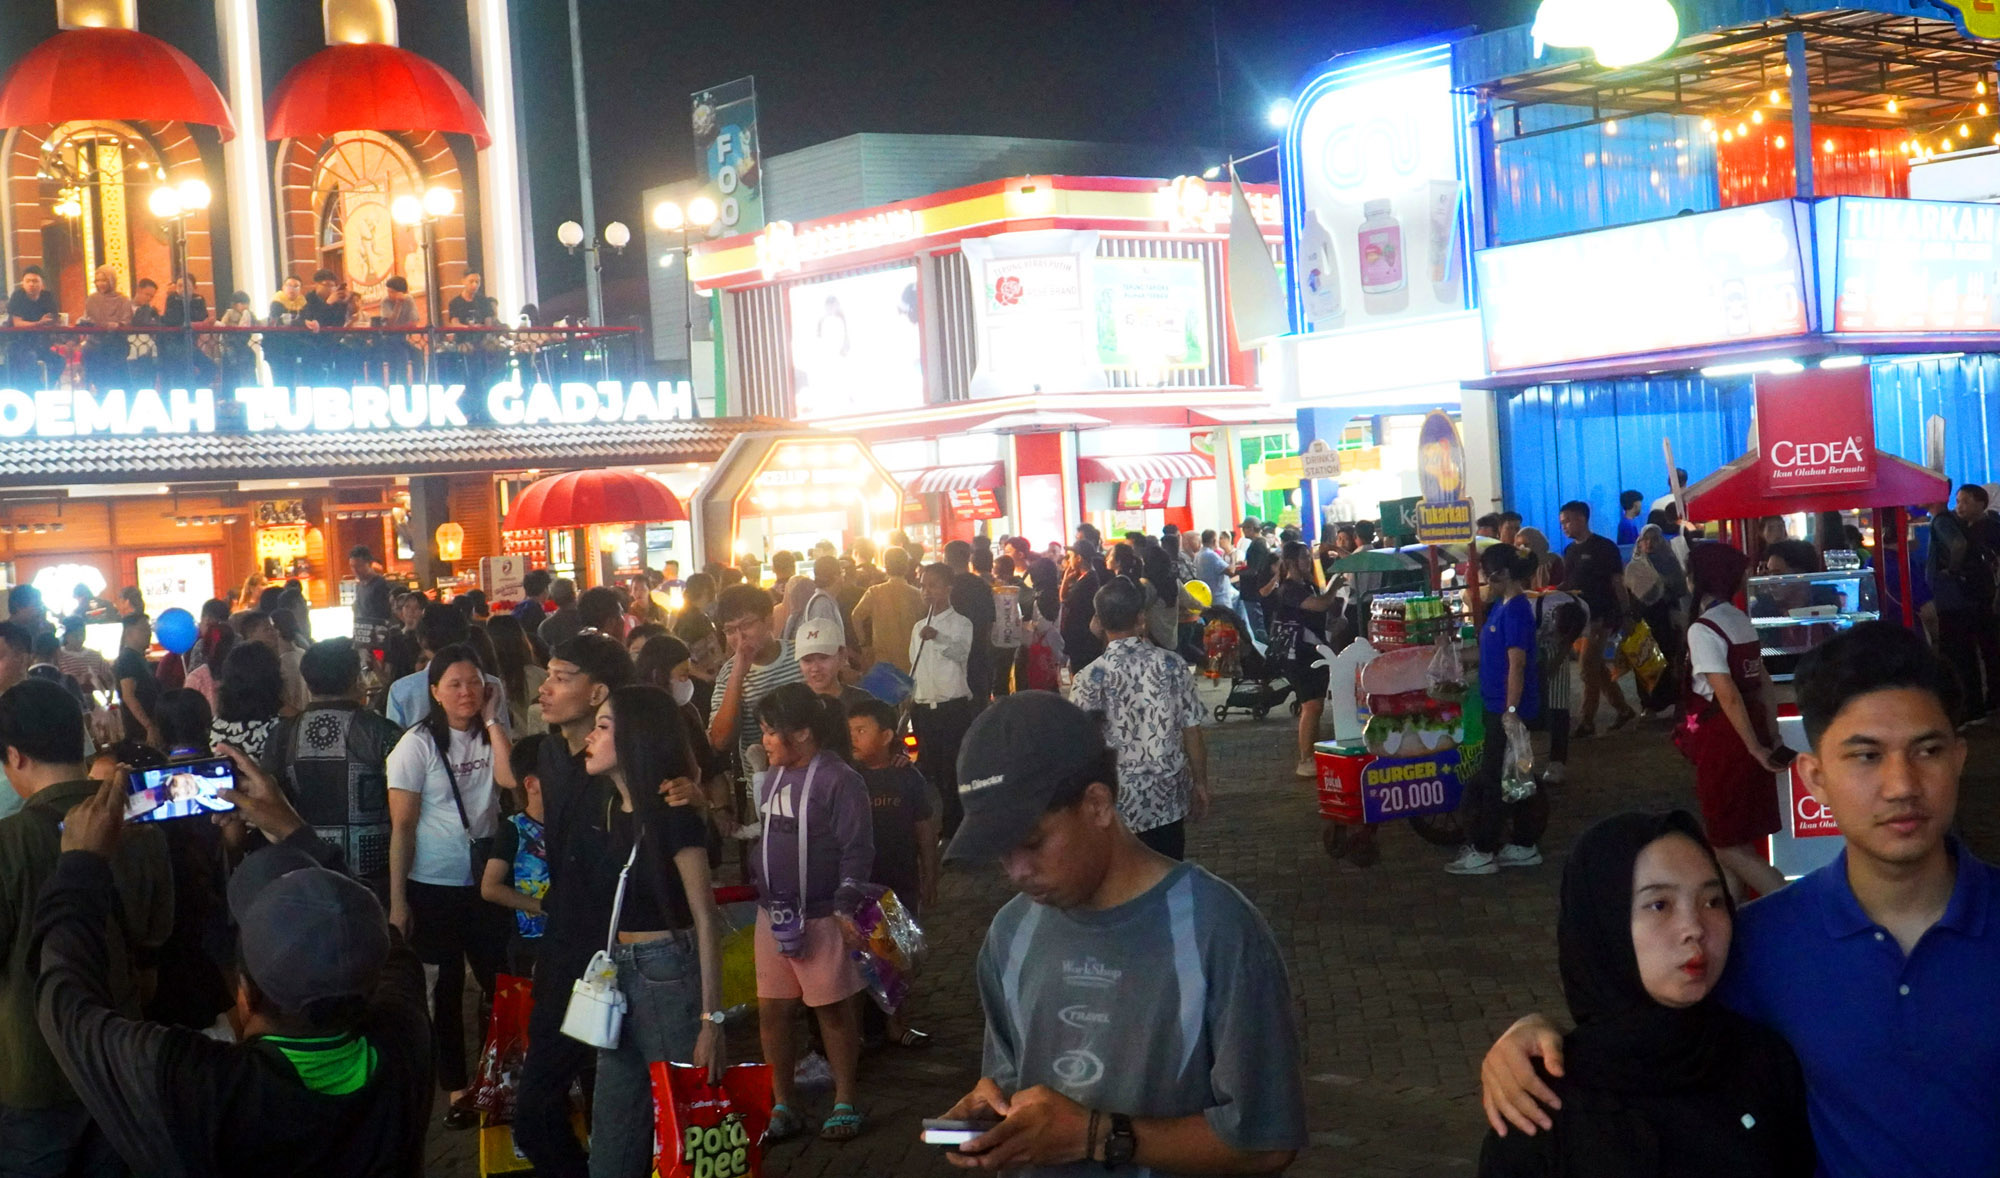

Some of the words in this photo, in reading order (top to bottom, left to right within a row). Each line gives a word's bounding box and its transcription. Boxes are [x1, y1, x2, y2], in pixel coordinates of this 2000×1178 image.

[716, 133, 740, 238] FOO
[1846, 202, 1994, 240] TUKARKAN
[234, 385, 468, 432] TUBRUK
[487, 380, 693, 425] GADJAH
[1305, 454, 1336, 466] DRINKS
[1771, 436, 1864, 468] CEDEA
[1305, 464, 1340, 477] STATION
[1773, 469, 1793, 478] Ikan
[1795, 467, 1826, 476] Olahan
[1828, 465, 1866, 475] Bermutu
[1420, 503, 1470, 525] Tukarkan
[807, 630, 820, 640] M
[1367, 762, 1438, 786] BURGER
[871, 793, 902, 808] pire
[1379, 780, 1444, 813] 20.000
[1797, 795, 1834, 820] CE
[1799, 821, 1818, 830] Ikan
[1818, 820, 1839, 829] Olah
[694, 1147, 747, 1178] bee
